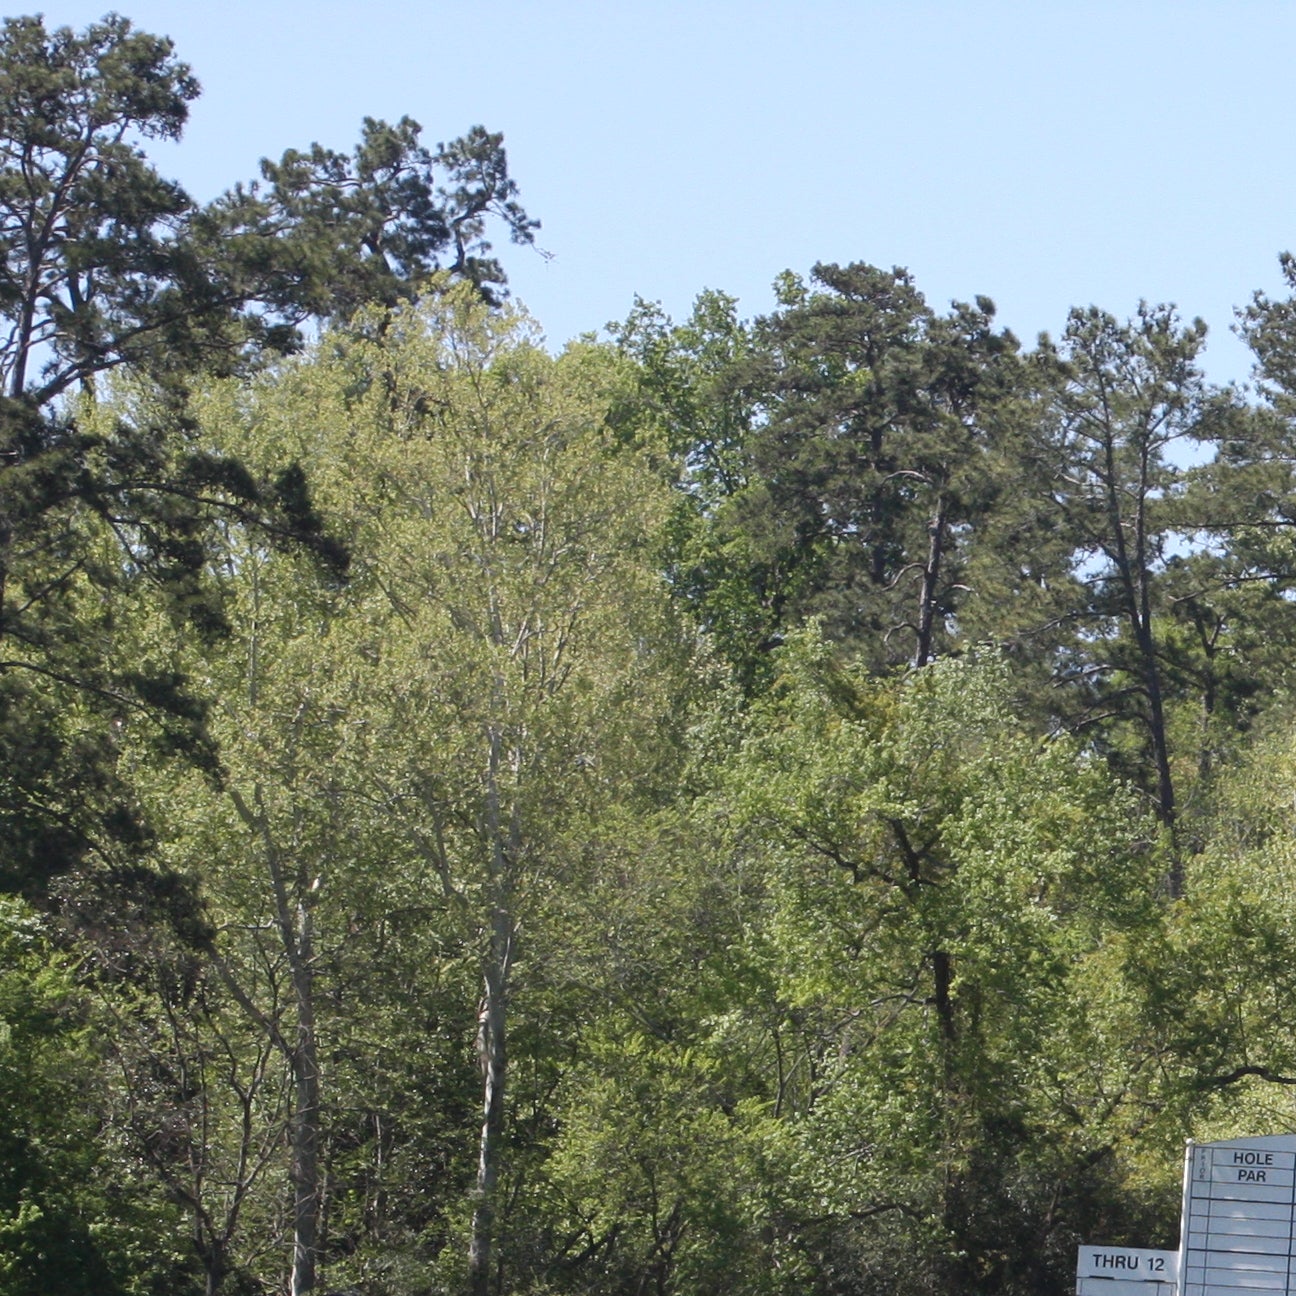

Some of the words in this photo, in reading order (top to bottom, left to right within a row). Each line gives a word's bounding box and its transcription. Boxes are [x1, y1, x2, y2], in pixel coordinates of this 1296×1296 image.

[1233, 1151, 1274, 1166] HOLE
[1238, 1169, 1266, 1182] PAR
[1093, 1254, 1139, 1270] THRU
[1147, 1258, 1165, 1271] 12
